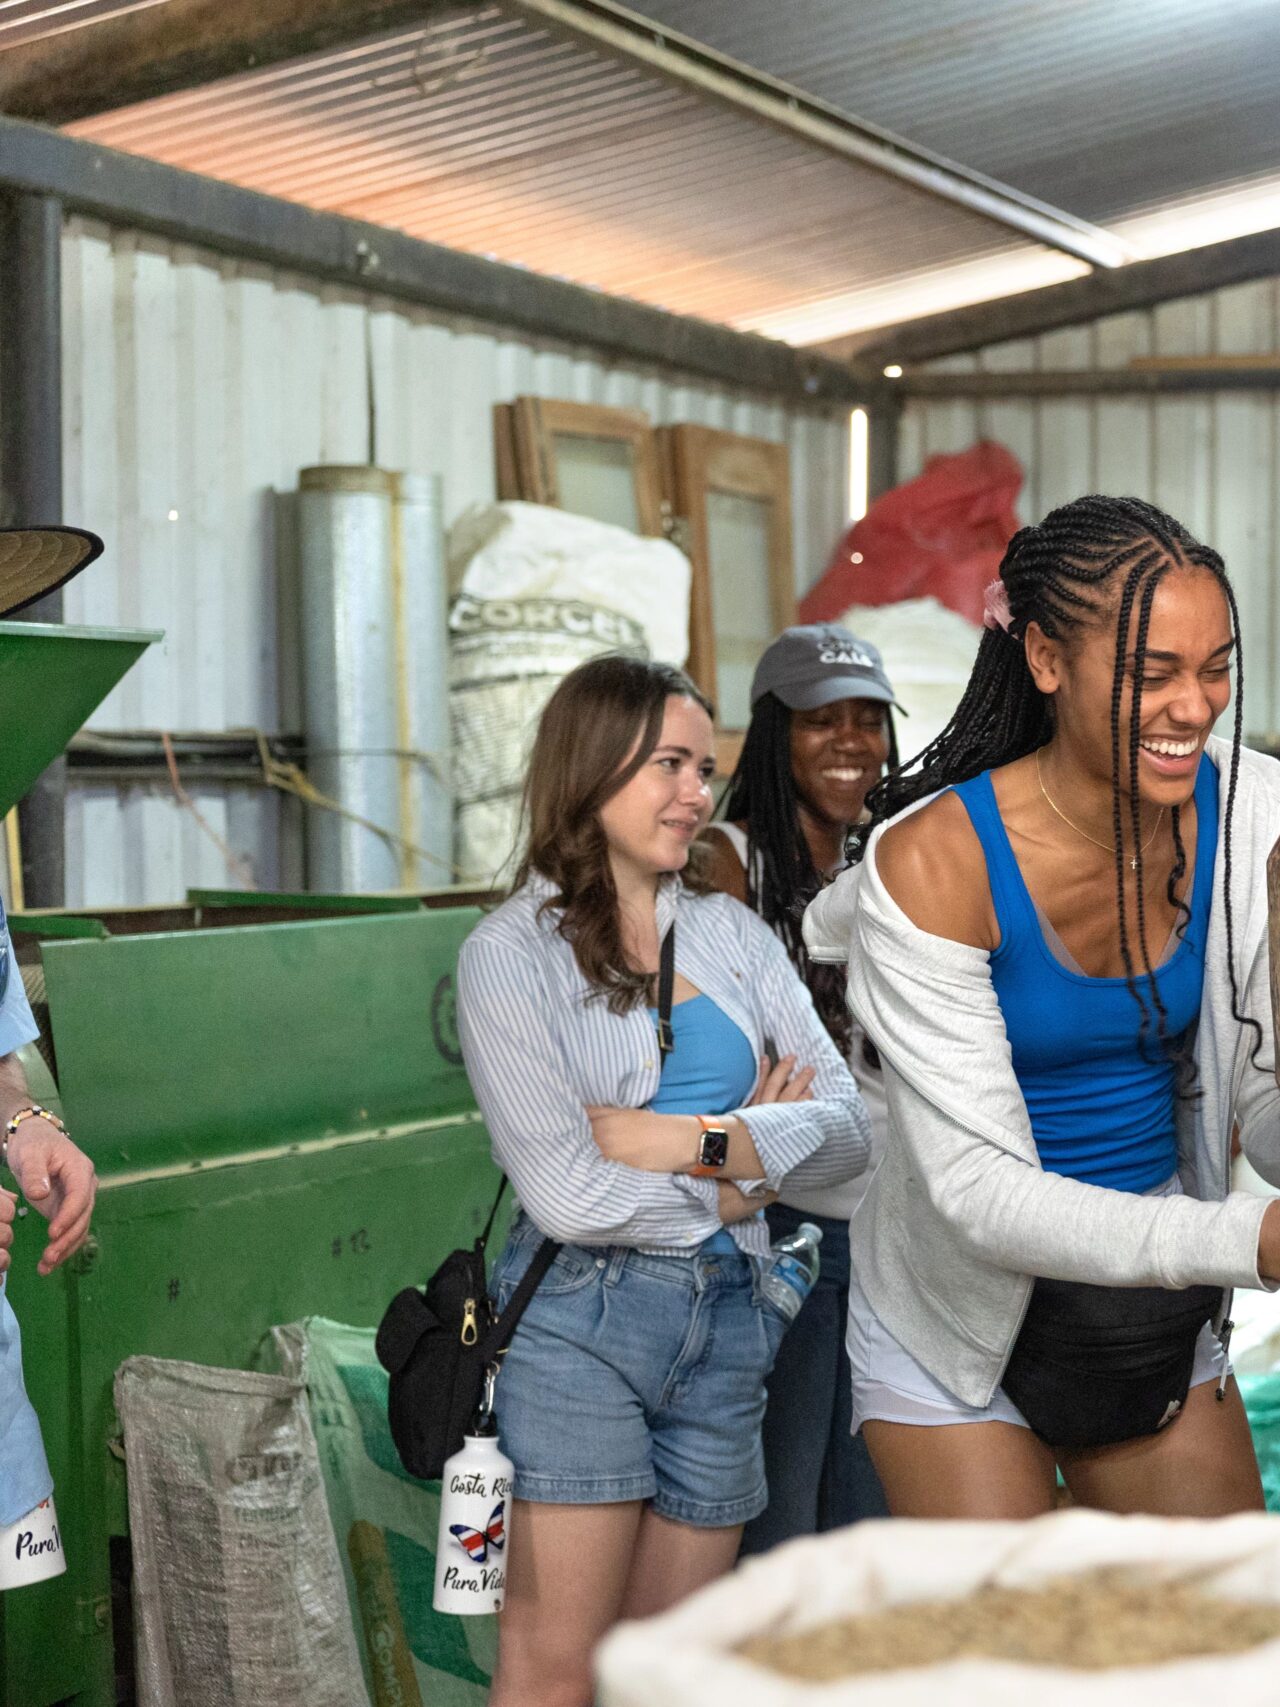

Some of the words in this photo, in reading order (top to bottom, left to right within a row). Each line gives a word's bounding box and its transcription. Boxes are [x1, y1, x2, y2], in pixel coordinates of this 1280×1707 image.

[450, 1473, 487, 1498] Costa
[15, 1531, 57, 1561] Pura
[443, 1565, 480, 1593] Pura
